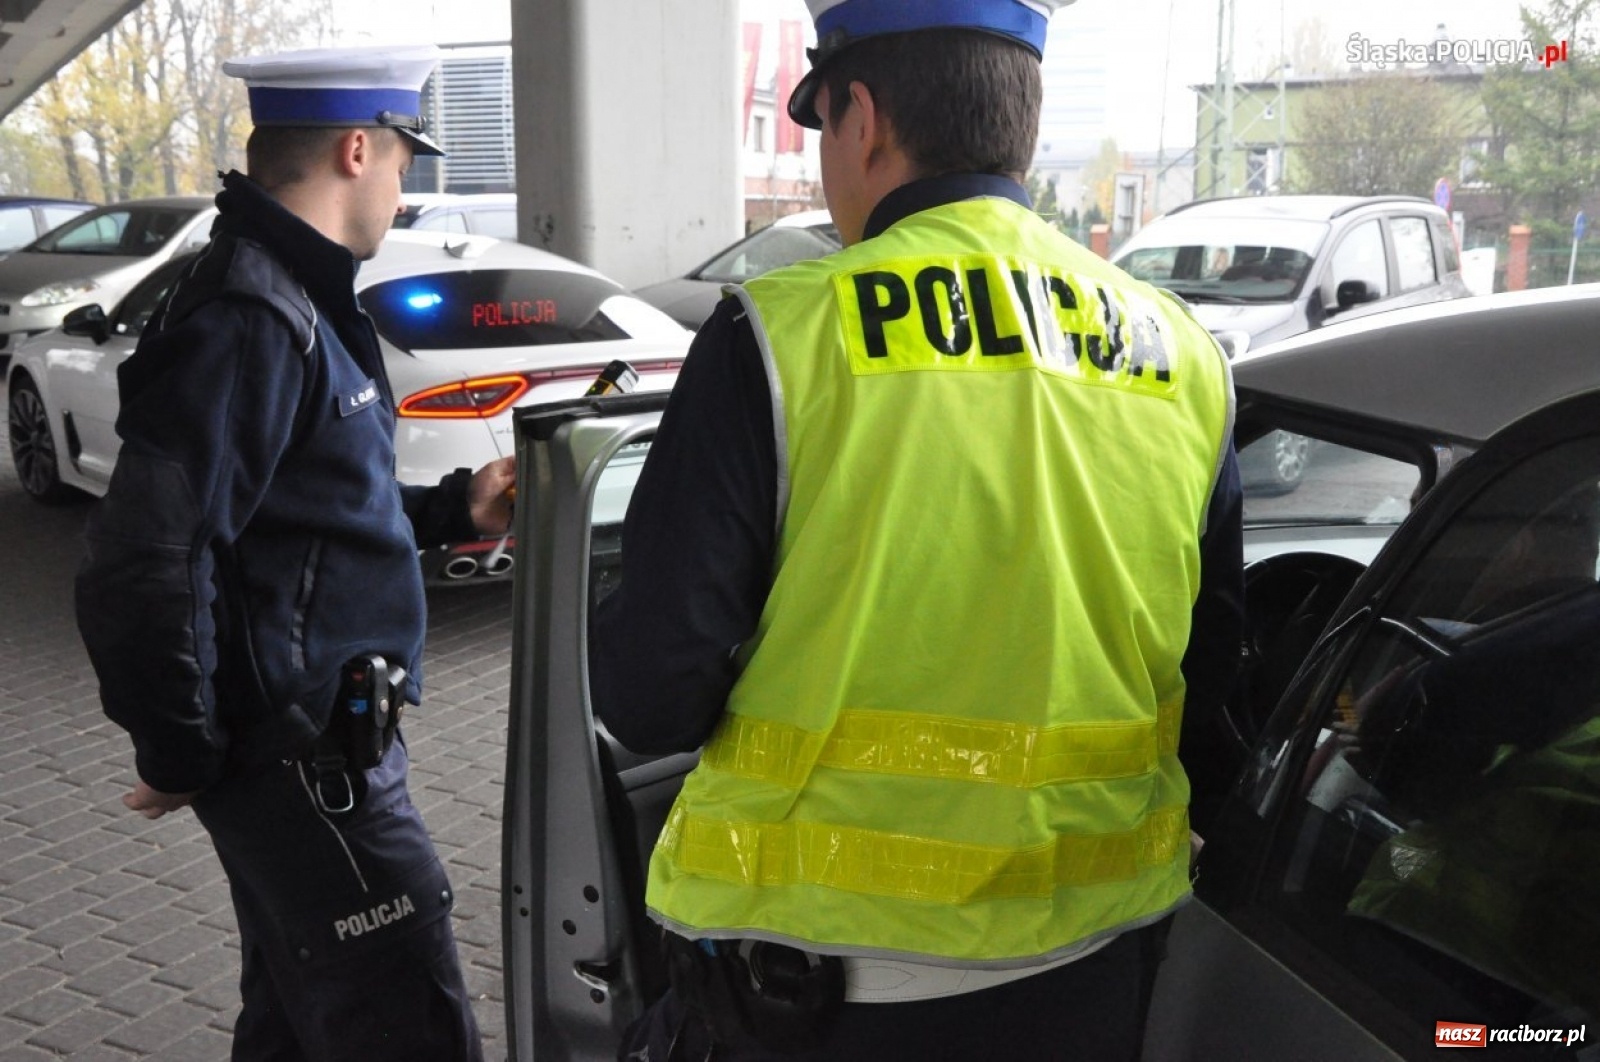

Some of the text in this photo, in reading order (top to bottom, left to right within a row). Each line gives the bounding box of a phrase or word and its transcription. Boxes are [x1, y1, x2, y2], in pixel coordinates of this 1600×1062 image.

[472, 300, 557, 328] POLICJA
[852, 265, 1171, 383] POLICJA
[334, 894, 415, 941] POLICJA
